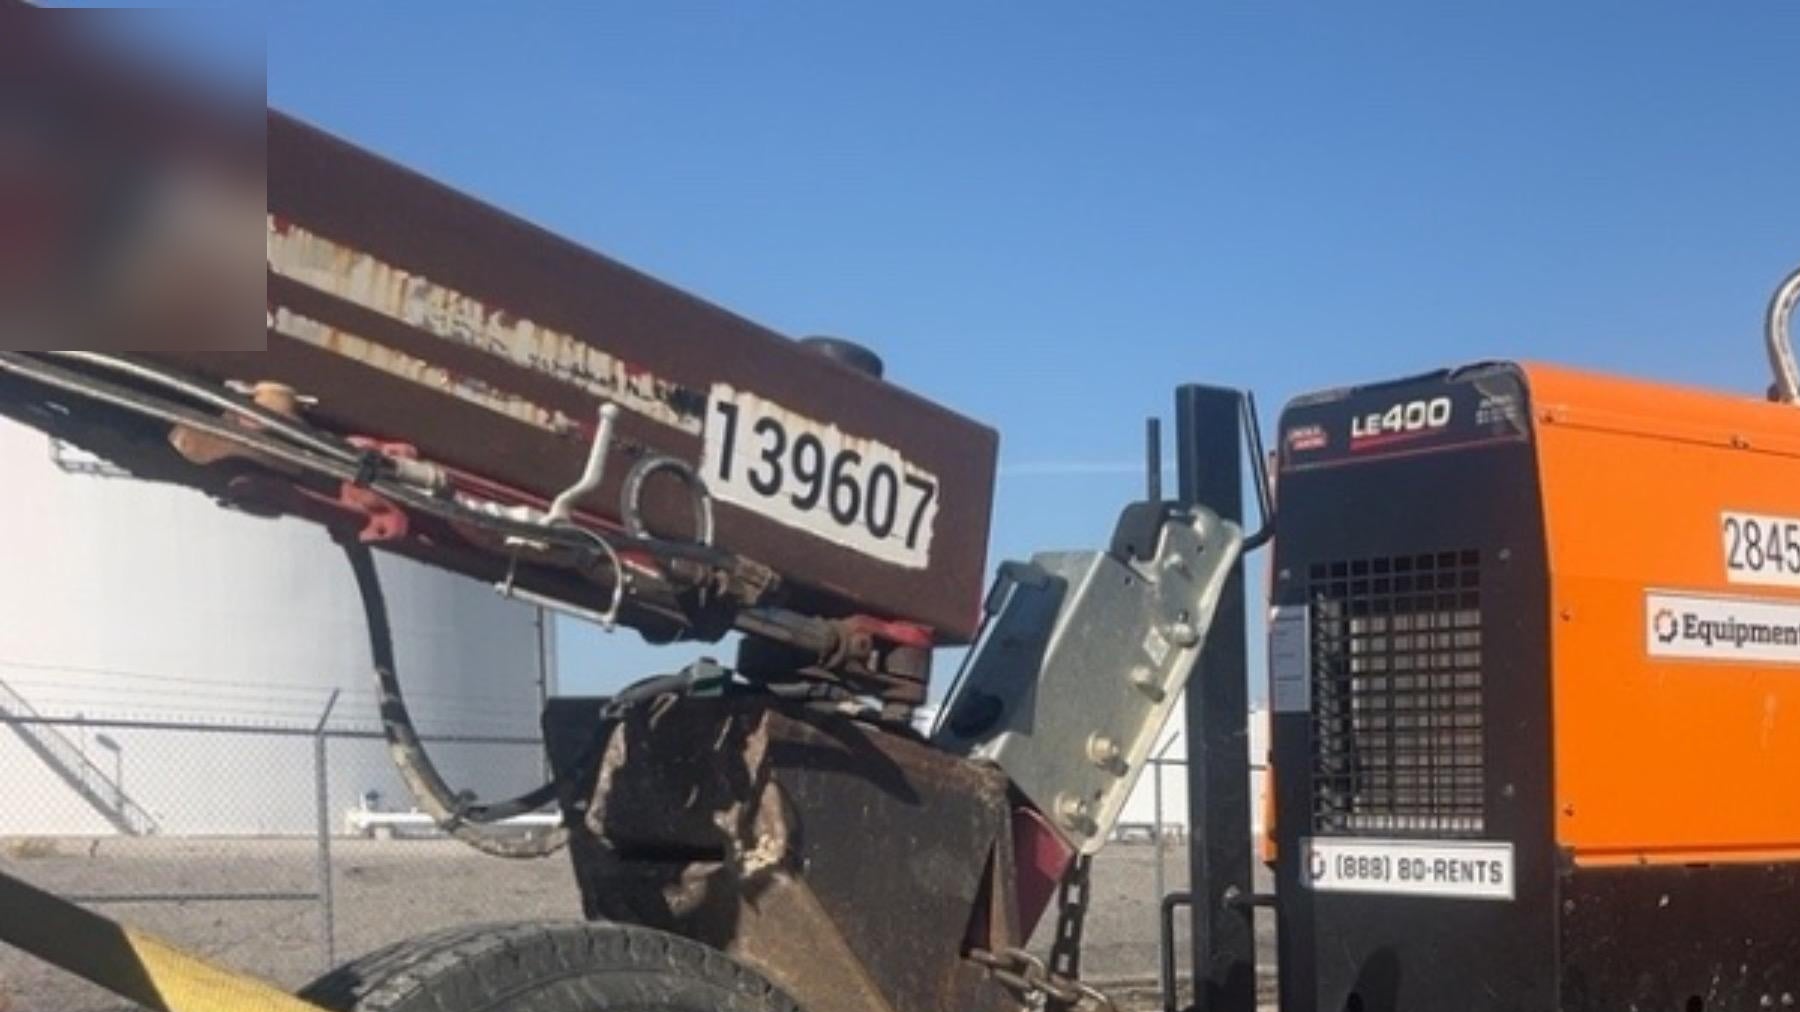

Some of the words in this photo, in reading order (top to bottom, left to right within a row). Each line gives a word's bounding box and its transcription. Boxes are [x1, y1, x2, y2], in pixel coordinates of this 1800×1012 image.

[1351, 397, 1452, 438] LE400
[715, 400, 936, 550] 139607
[1335, 854, 1391, 882] (888)
